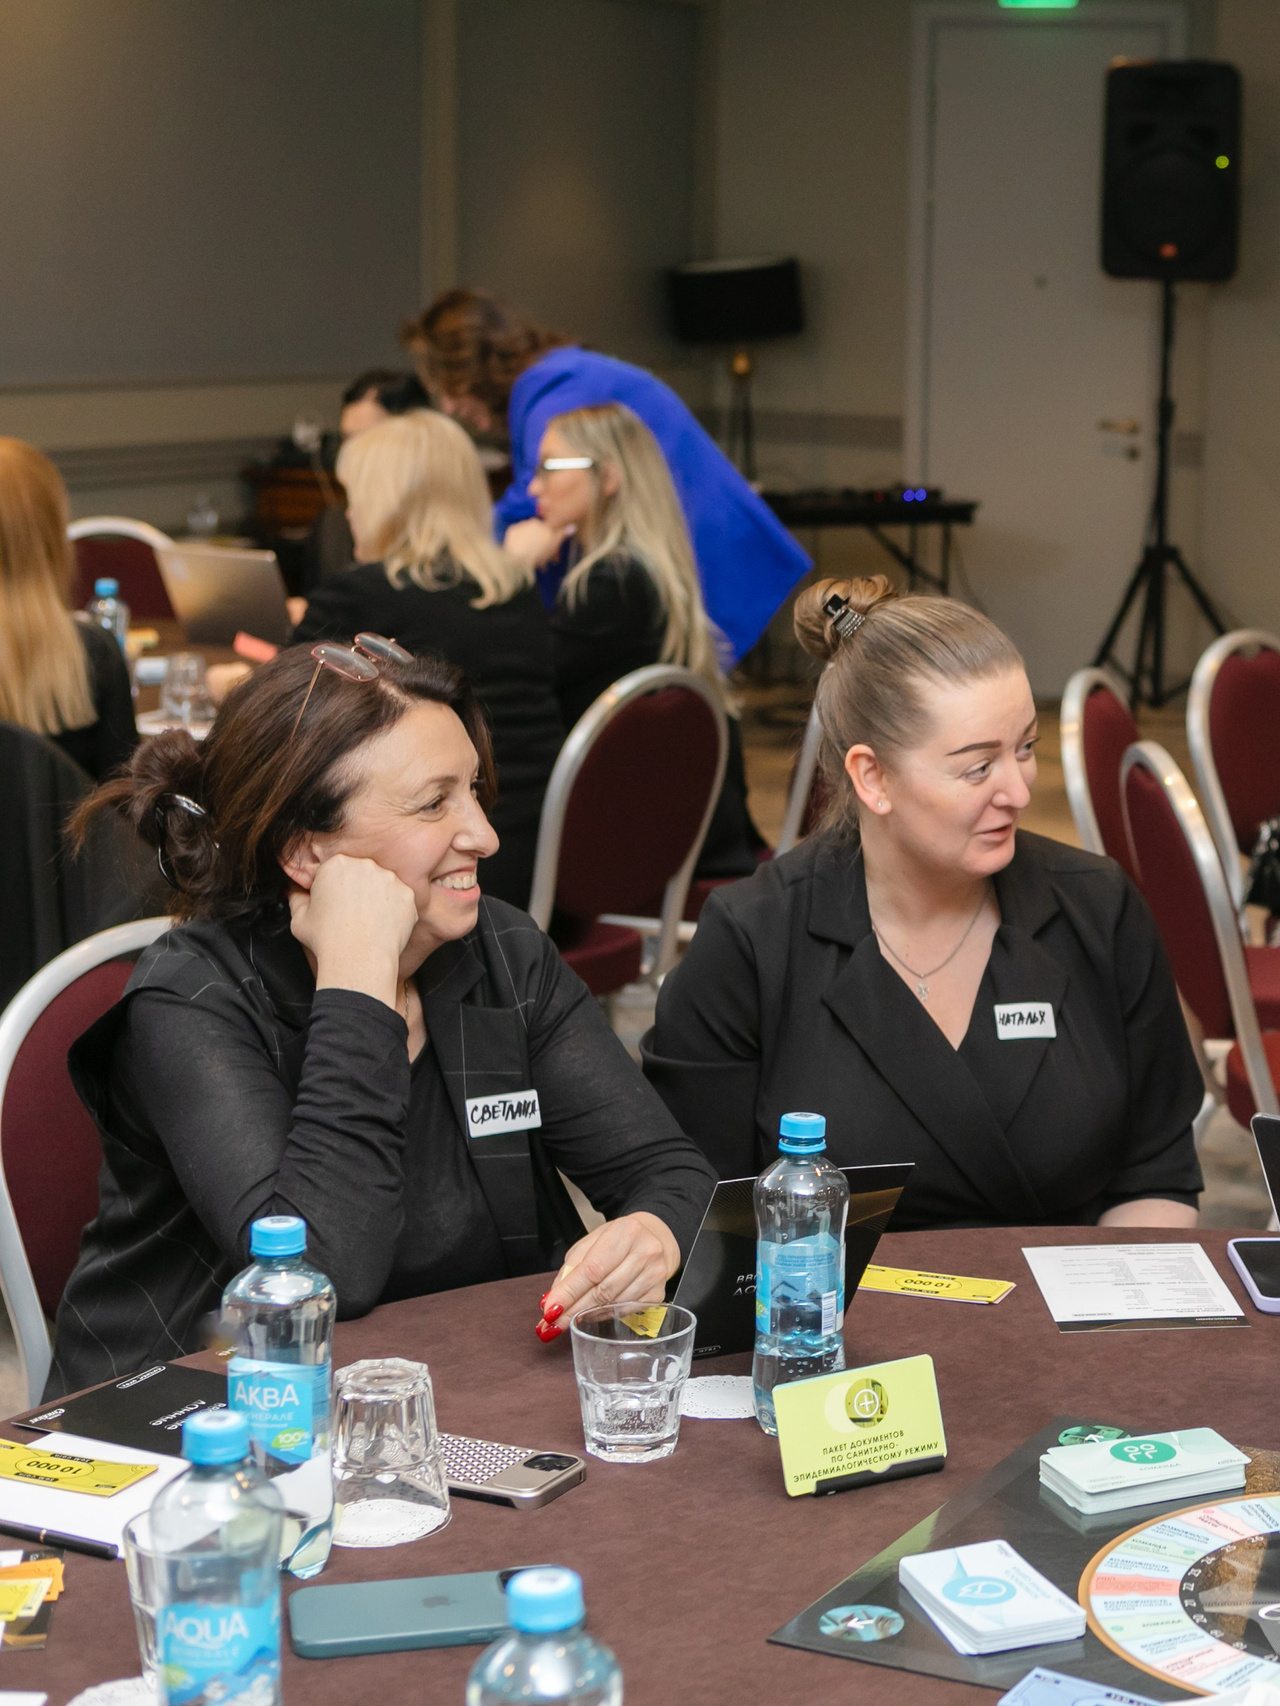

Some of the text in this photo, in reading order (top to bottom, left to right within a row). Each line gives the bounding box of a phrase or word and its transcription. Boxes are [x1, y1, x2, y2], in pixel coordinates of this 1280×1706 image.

[235, 1380, 300, 1411] АКВА
[823, 1430, 905, 1455] ПАКЕТ ДОКУМЕНТОВ
[831, 1443, 899, 1464] ПО САНИТАРНО-
[26, 1461, 82, 1475] 10 000
[793, 1442, 939, 1483] ЭПИДЕМИАЛОГИЧЕСКОМУ РЕЖИМУ
[164, 1610, 249, 1650] AQUA
